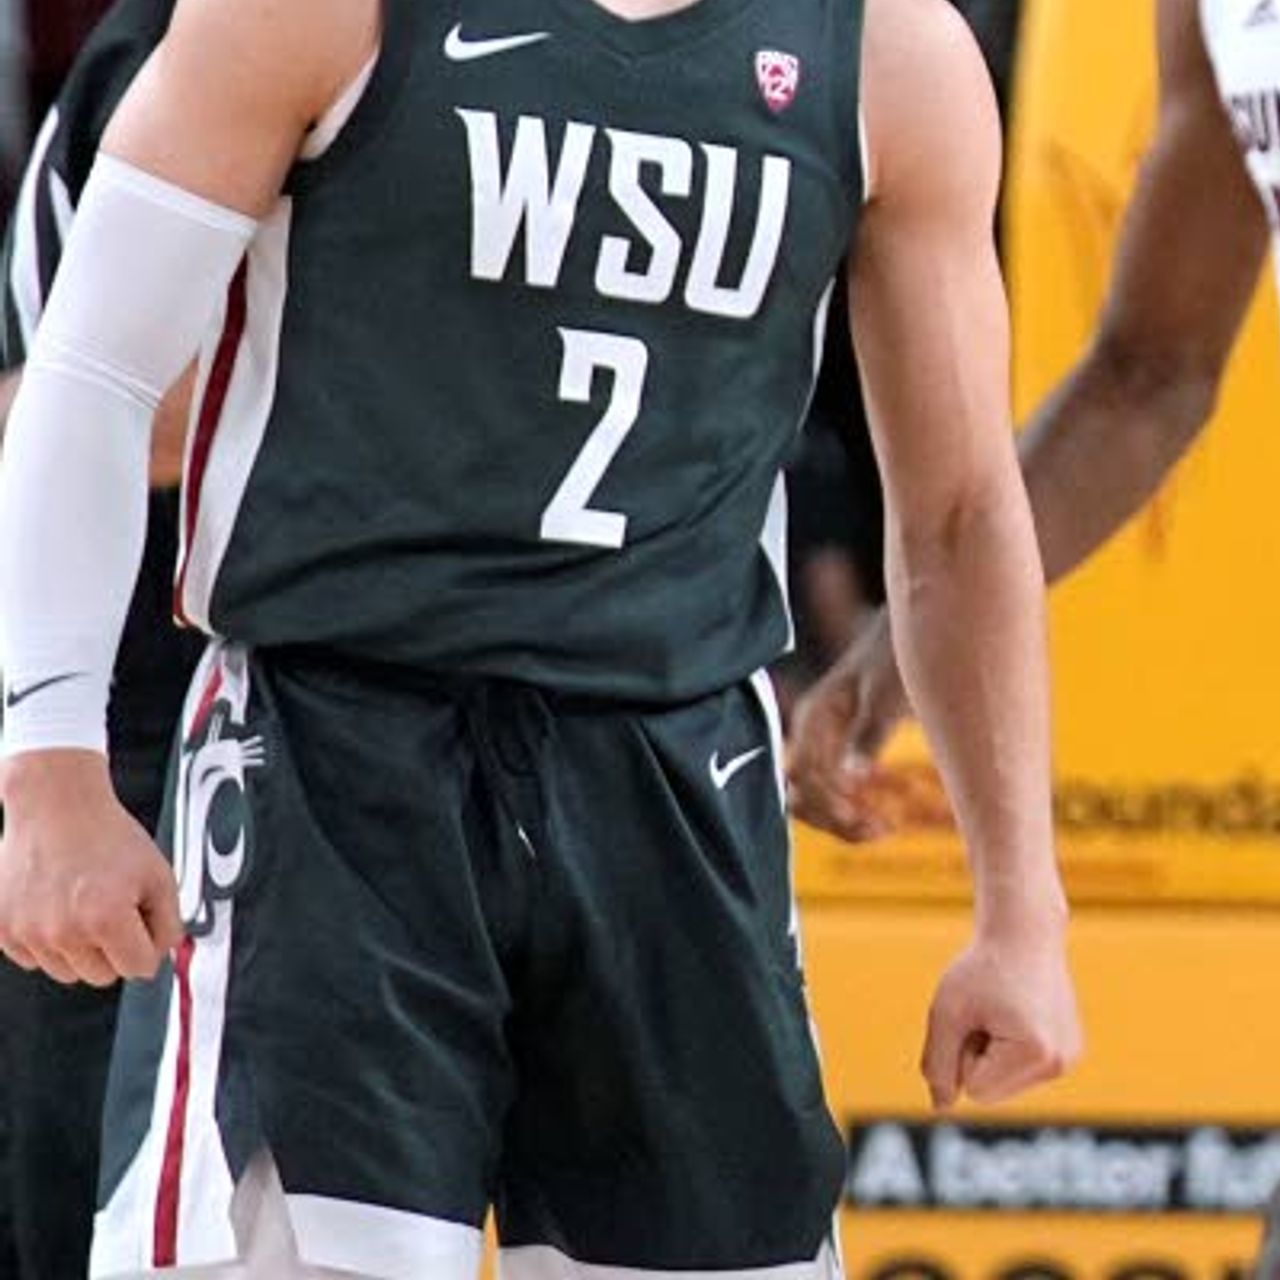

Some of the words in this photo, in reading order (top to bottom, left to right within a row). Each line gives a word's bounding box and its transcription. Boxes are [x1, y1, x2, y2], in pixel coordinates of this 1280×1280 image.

[454, 107, 791, 318] WSU
[540, 326, 648, 548] 2
[855, 1122, 925, 1207] A
